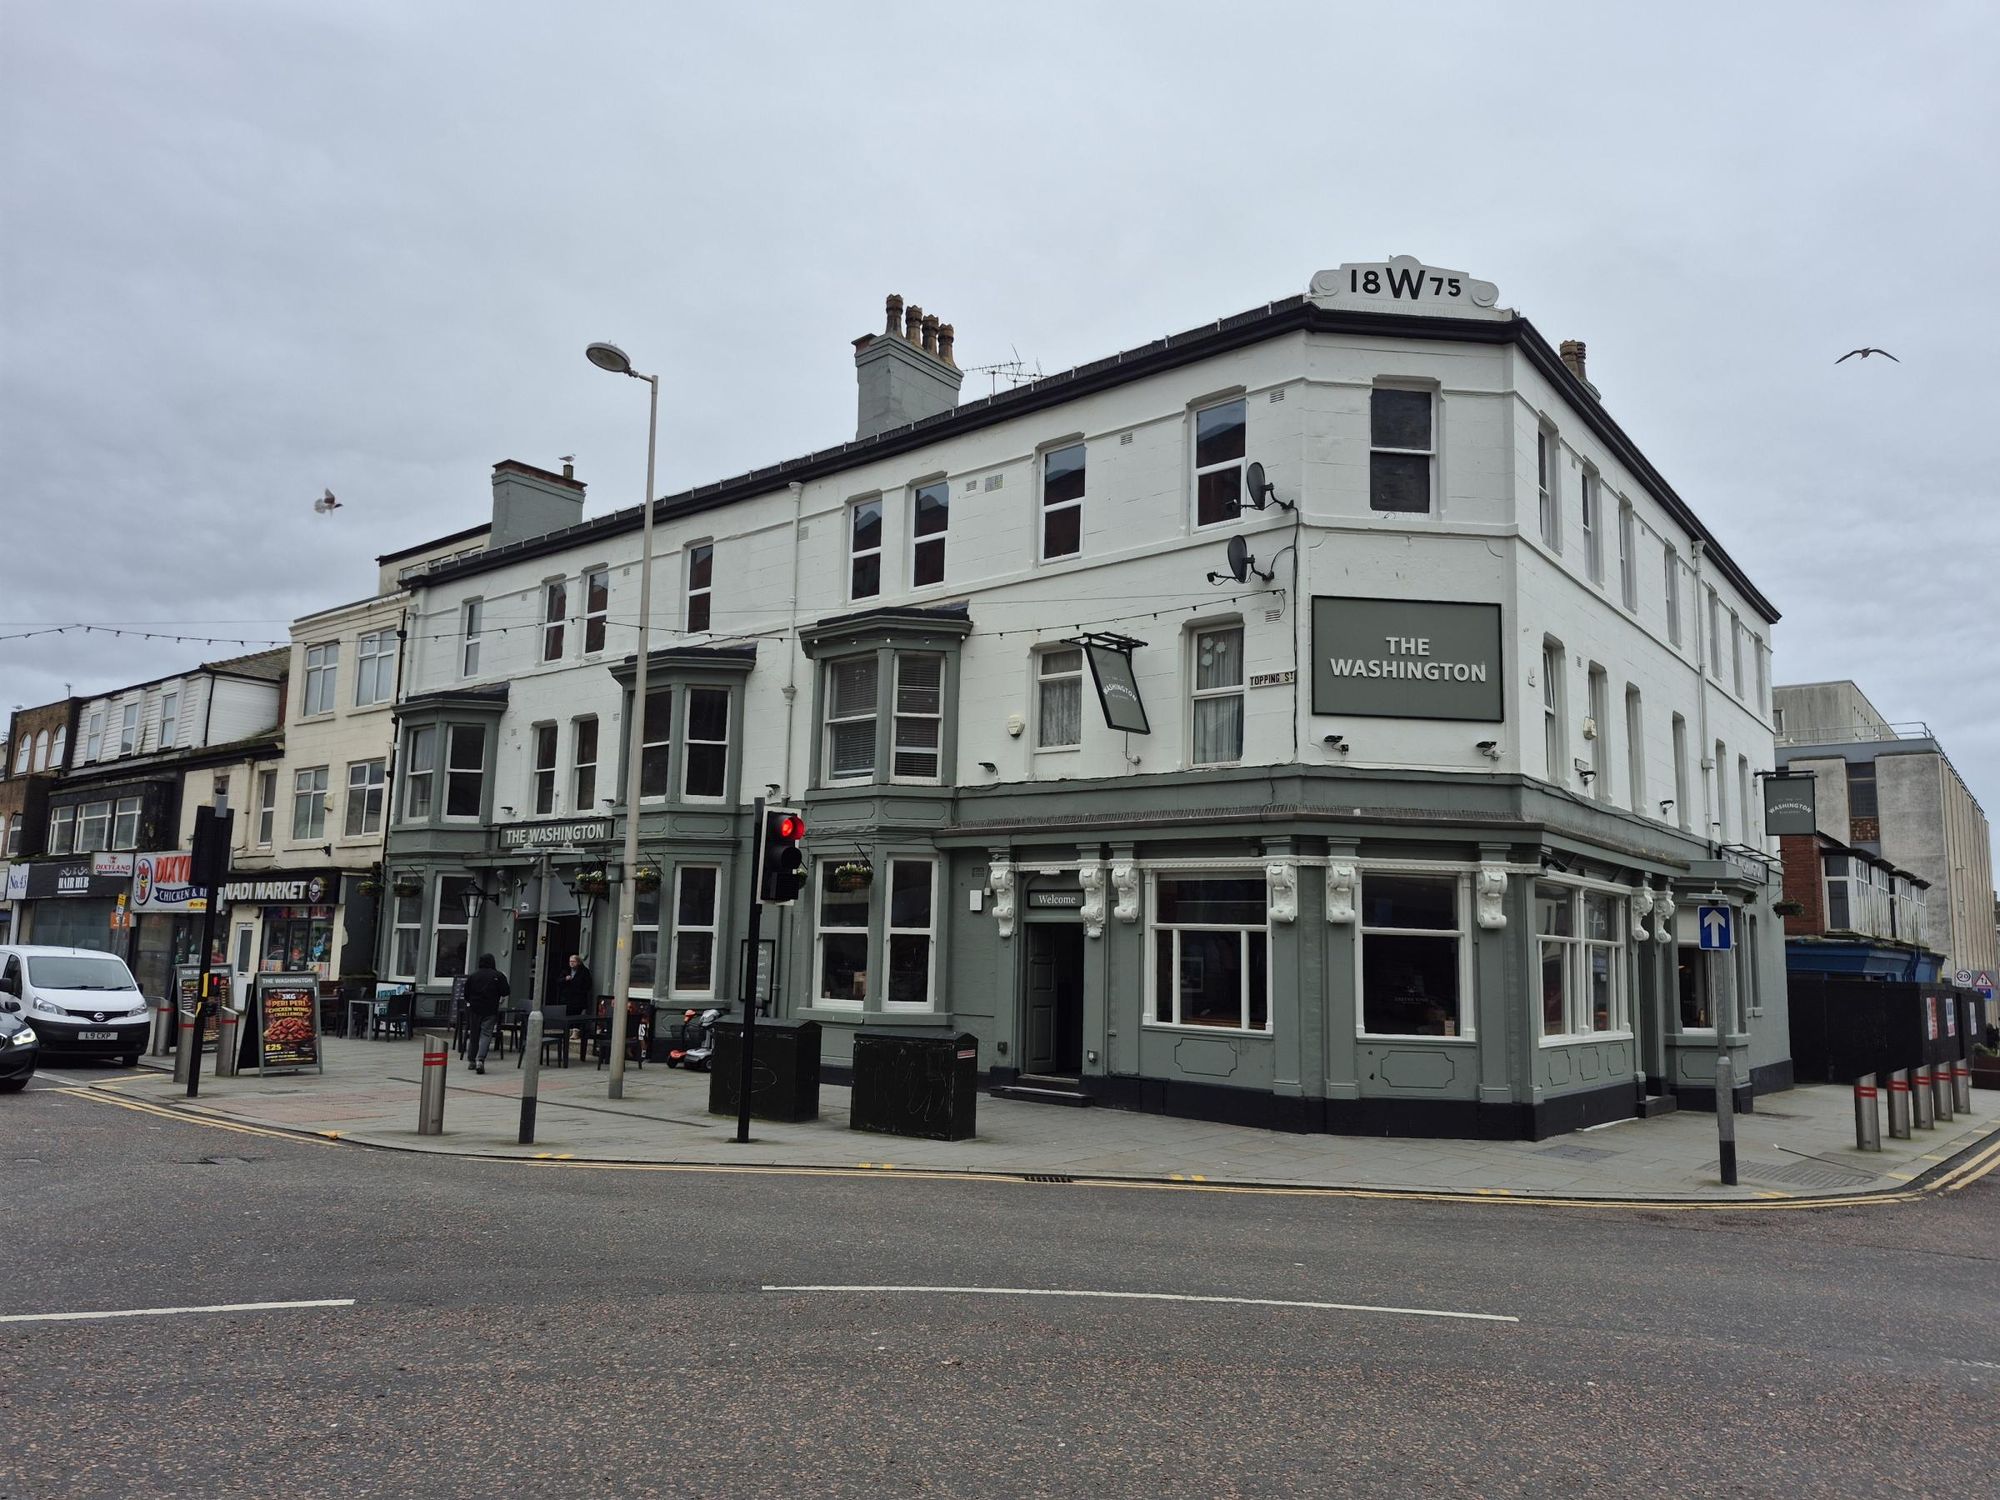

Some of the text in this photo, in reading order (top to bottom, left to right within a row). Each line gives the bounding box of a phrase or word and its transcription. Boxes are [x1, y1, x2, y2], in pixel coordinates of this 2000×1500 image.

[1385, 636, 1430, 656] THE
[1330, 658, 1486, 682] WASHINGTON
[1250, 673, 1280, 686] TOPPING
[1768, 803, 1812, 814] WASHINGTON
[506, 824, 605, 843] THE WASHINGTON
[95, 864, 131, 872] DIXYLAND
[58, 876, 89, 889] HAIR HUB
[159, 888, 190, 901] CHICKEN
[255, 881, 307, 900] MARKET
[1039, 894, 1076, 904] Welcome
